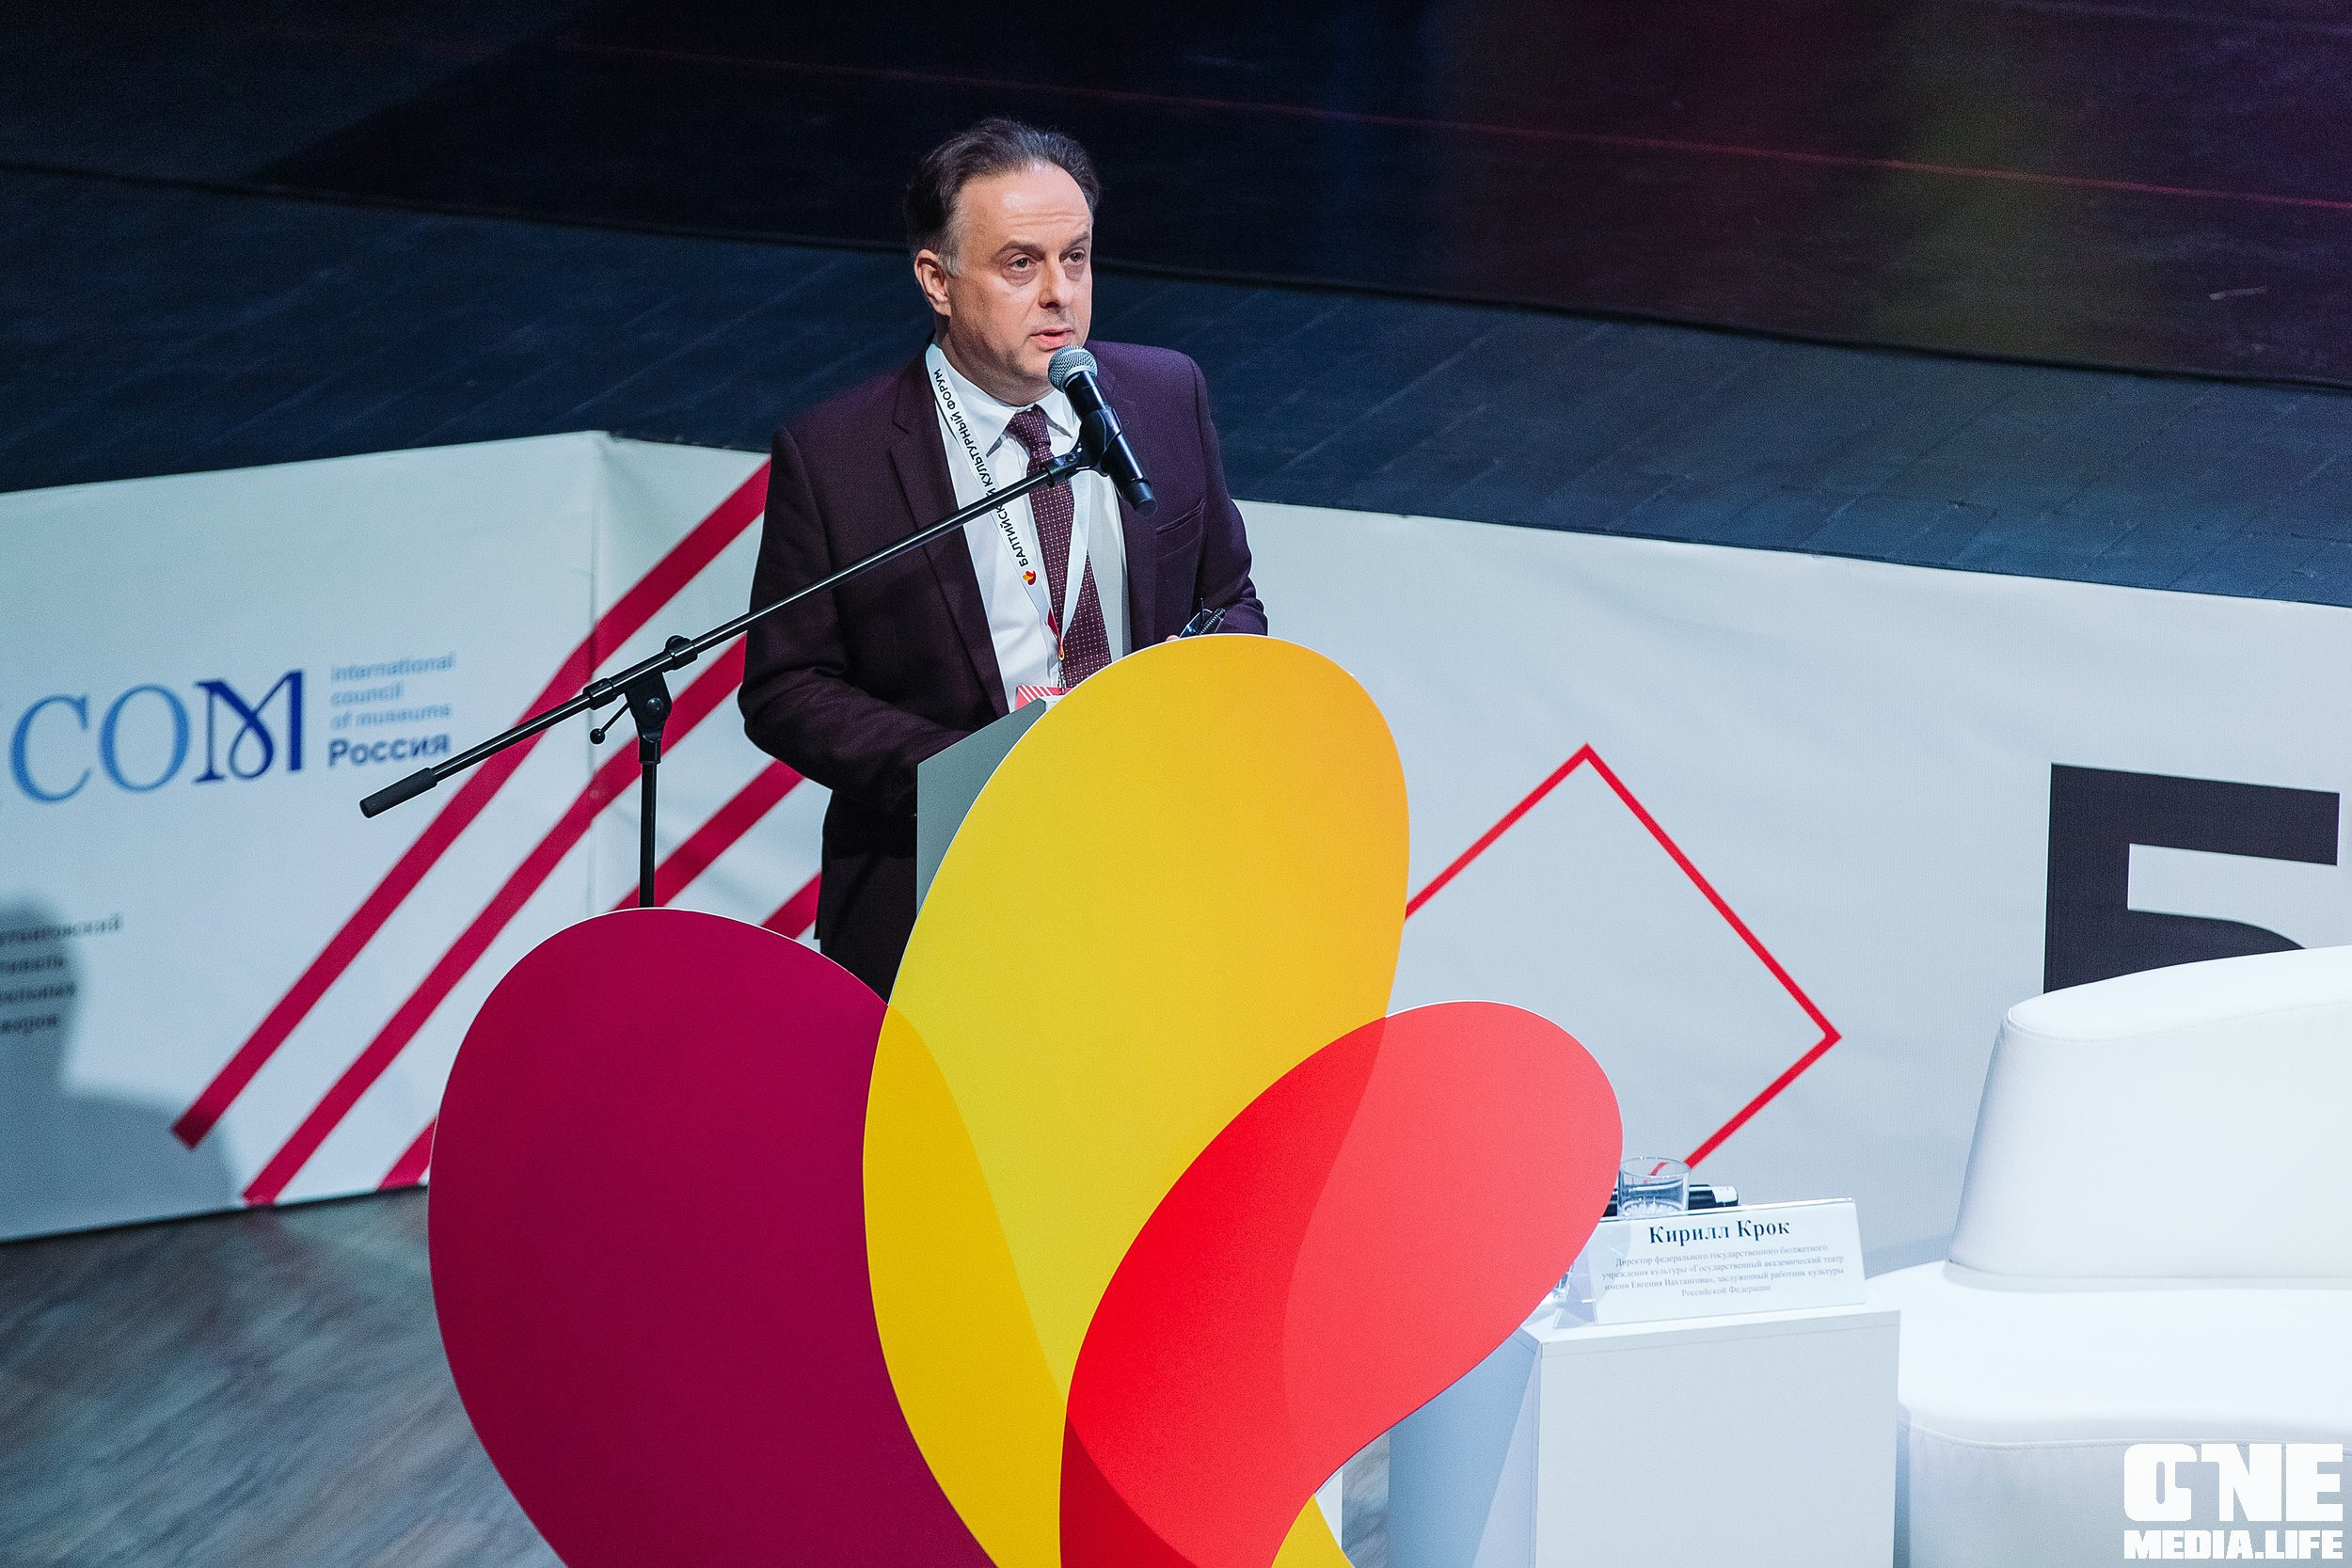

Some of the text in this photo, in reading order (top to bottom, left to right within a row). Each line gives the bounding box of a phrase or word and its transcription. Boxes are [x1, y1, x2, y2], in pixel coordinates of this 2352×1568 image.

[933, 369, 1028, 567] БАЛТИЙСКЙ КУЛЬТУРНЫЙ ФОРУМ
[0, 669, 305, 804] COM
[328, 734, 451, 768] Россия
[1649, 1219, 1790, 1246] Кирилл Крок
[1602, 1270, 1648, 1280] учреждения
[1650, 1267, 1687, 1276] культуры
[1764, 1255, 1822, 1267] академический
[1824, 1254, 1844, 1263] театр
[1615, 1244, 1828, 1268] Директор федерального государственного бюджетного
[1631, 1279, 1662, 1289] Евгения
[1718, 1272, 1770, 1283] заслуженный
[1771, 1270, 1806, 1280] работник
[1808, 1267, 1845, 1277] культуры
[1681, 1284, 1772, 1297] Российской Федерации
